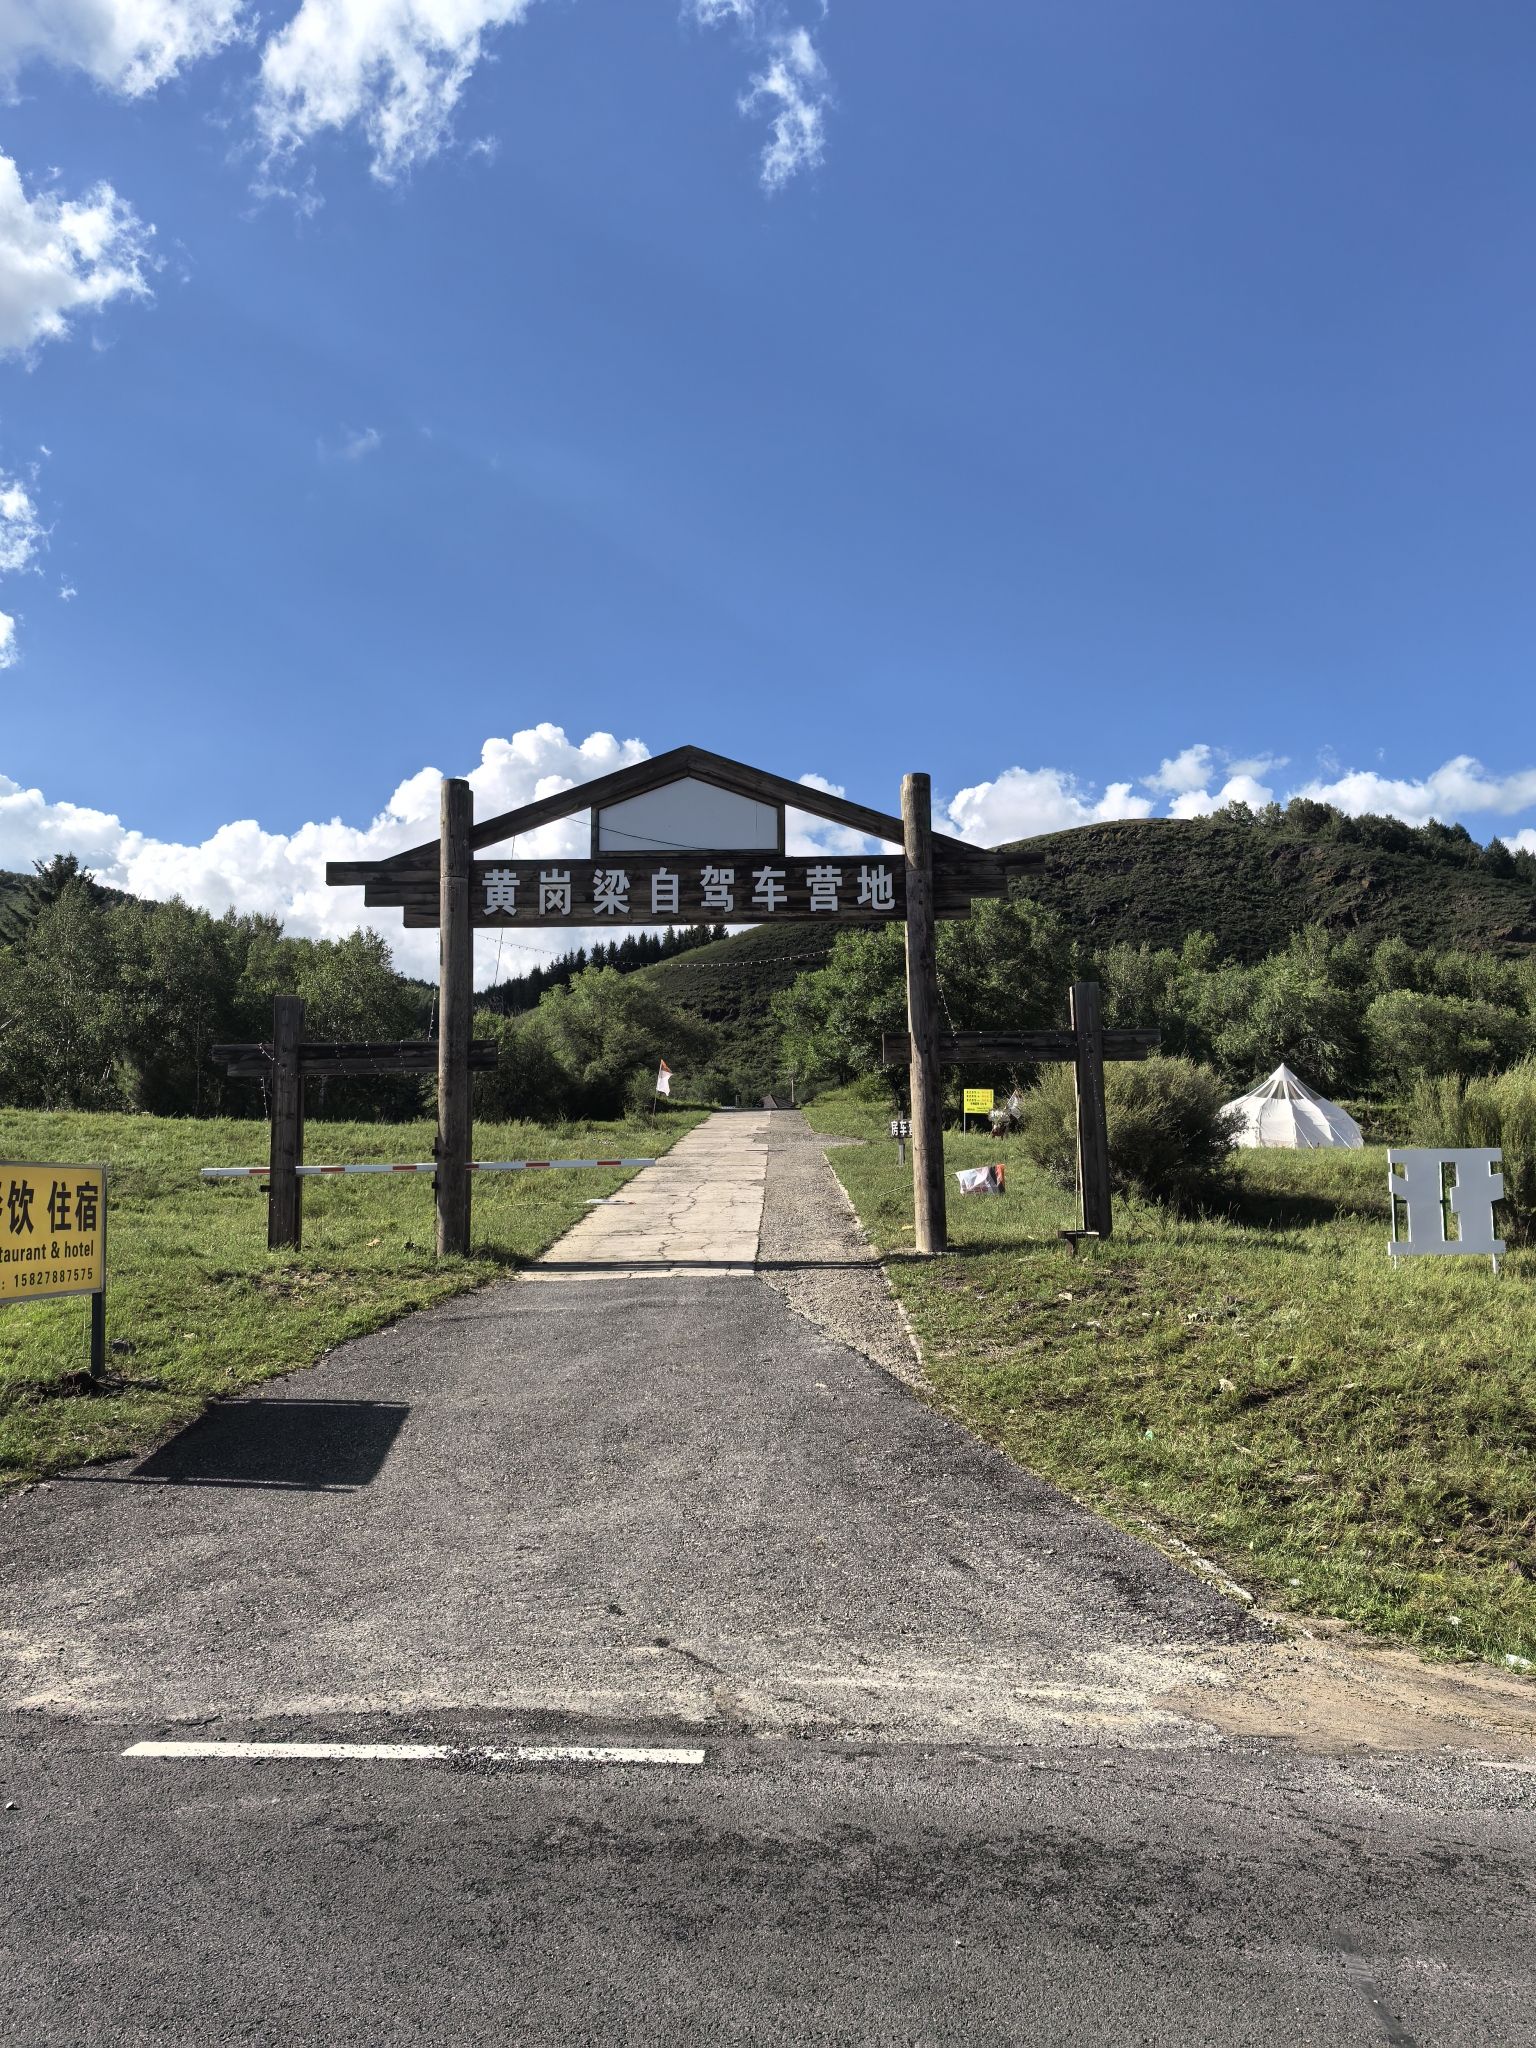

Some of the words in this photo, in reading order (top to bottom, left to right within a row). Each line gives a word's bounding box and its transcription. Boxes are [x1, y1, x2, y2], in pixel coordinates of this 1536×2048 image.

[482, 865, 897, 915] 黄岗梁自驾车营地
[0, 1180, 34, 1235] 饮
[47, 1180, 98, 1234] 住宿
[51, 1241, 60, 1258] &
[65, 1240, 94, 1258] hotel
